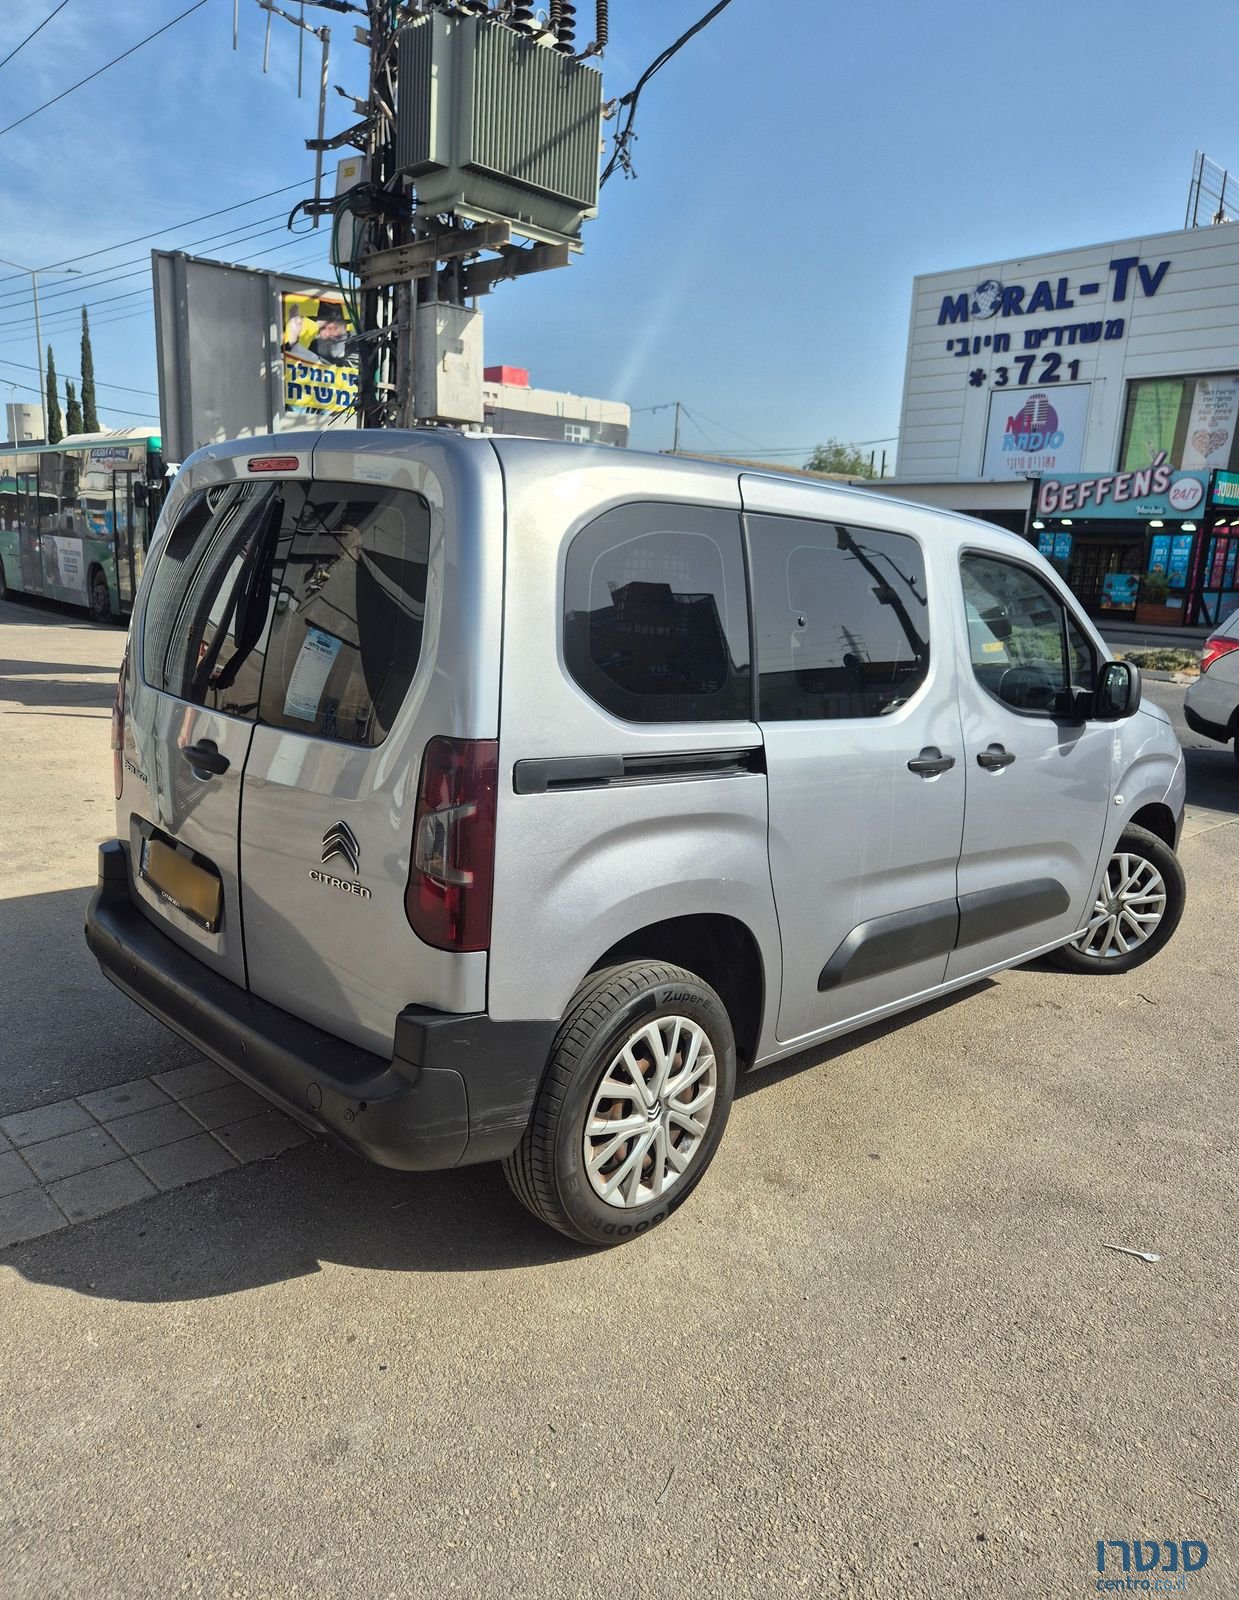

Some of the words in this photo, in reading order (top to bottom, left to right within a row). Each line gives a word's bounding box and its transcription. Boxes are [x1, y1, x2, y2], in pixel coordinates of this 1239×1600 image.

[946, 333, 1010, 358] חיובי
[1024, 318, 1125, 350] משדרים
[286, 363, 335, 384] המלך
[288, 382, 357, 407] משיח
[1002, 431, 1064, 451] RADIO
[1040, 452, 1172, 513] GEFFEN'S
[1172, 487, 1199, 500] 24/7
